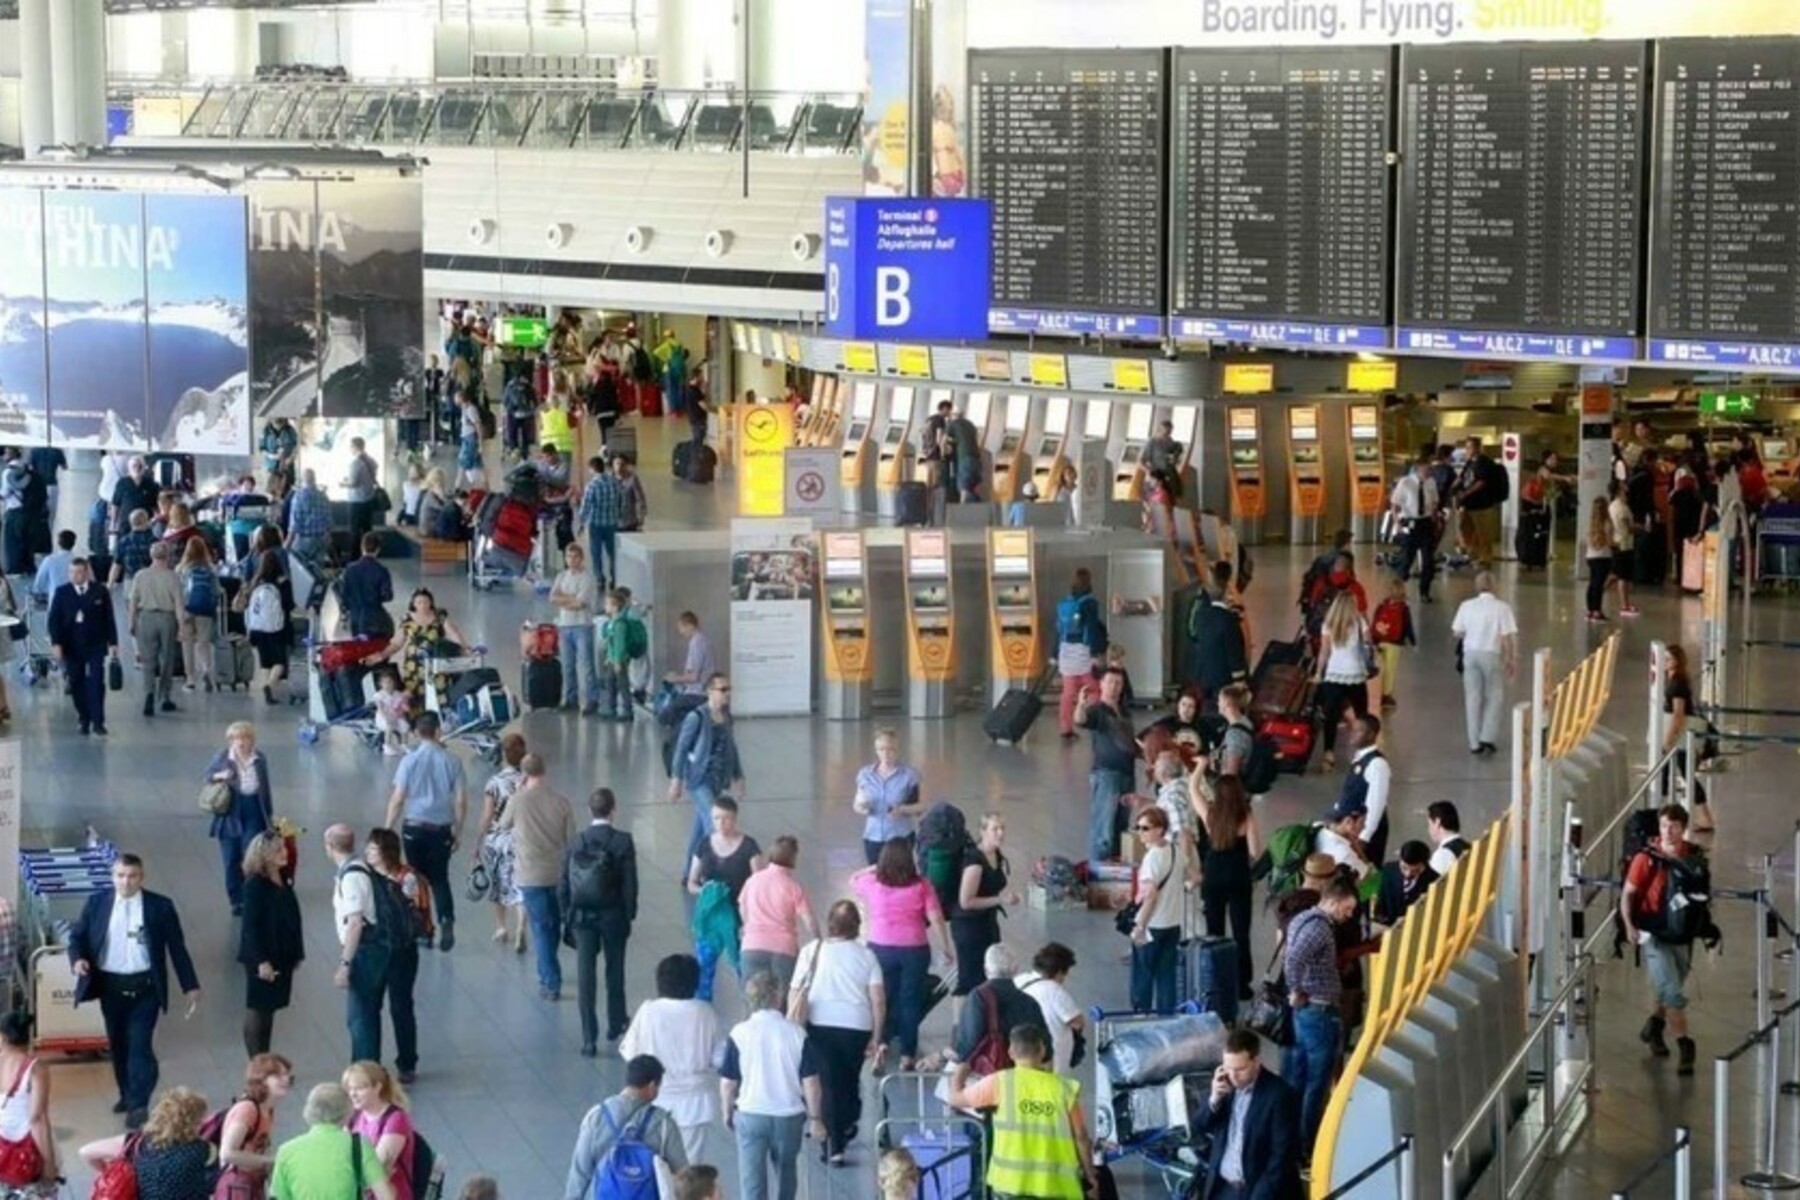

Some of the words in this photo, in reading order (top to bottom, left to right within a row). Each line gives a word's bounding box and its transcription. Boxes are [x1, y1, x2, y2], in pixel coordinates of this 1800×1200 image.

[1202, 0, 1346, 37] Boarding.
[1359, 0, 1463, 37] Flying.
[1475, 0, 1611, 34] Smiling.
[877, 209, 921, 221] Terminal
[877, 224, 936, 237] Abflughalle
[877, 238, 932, 251] Departures
[877, 266, 911, 326] B
